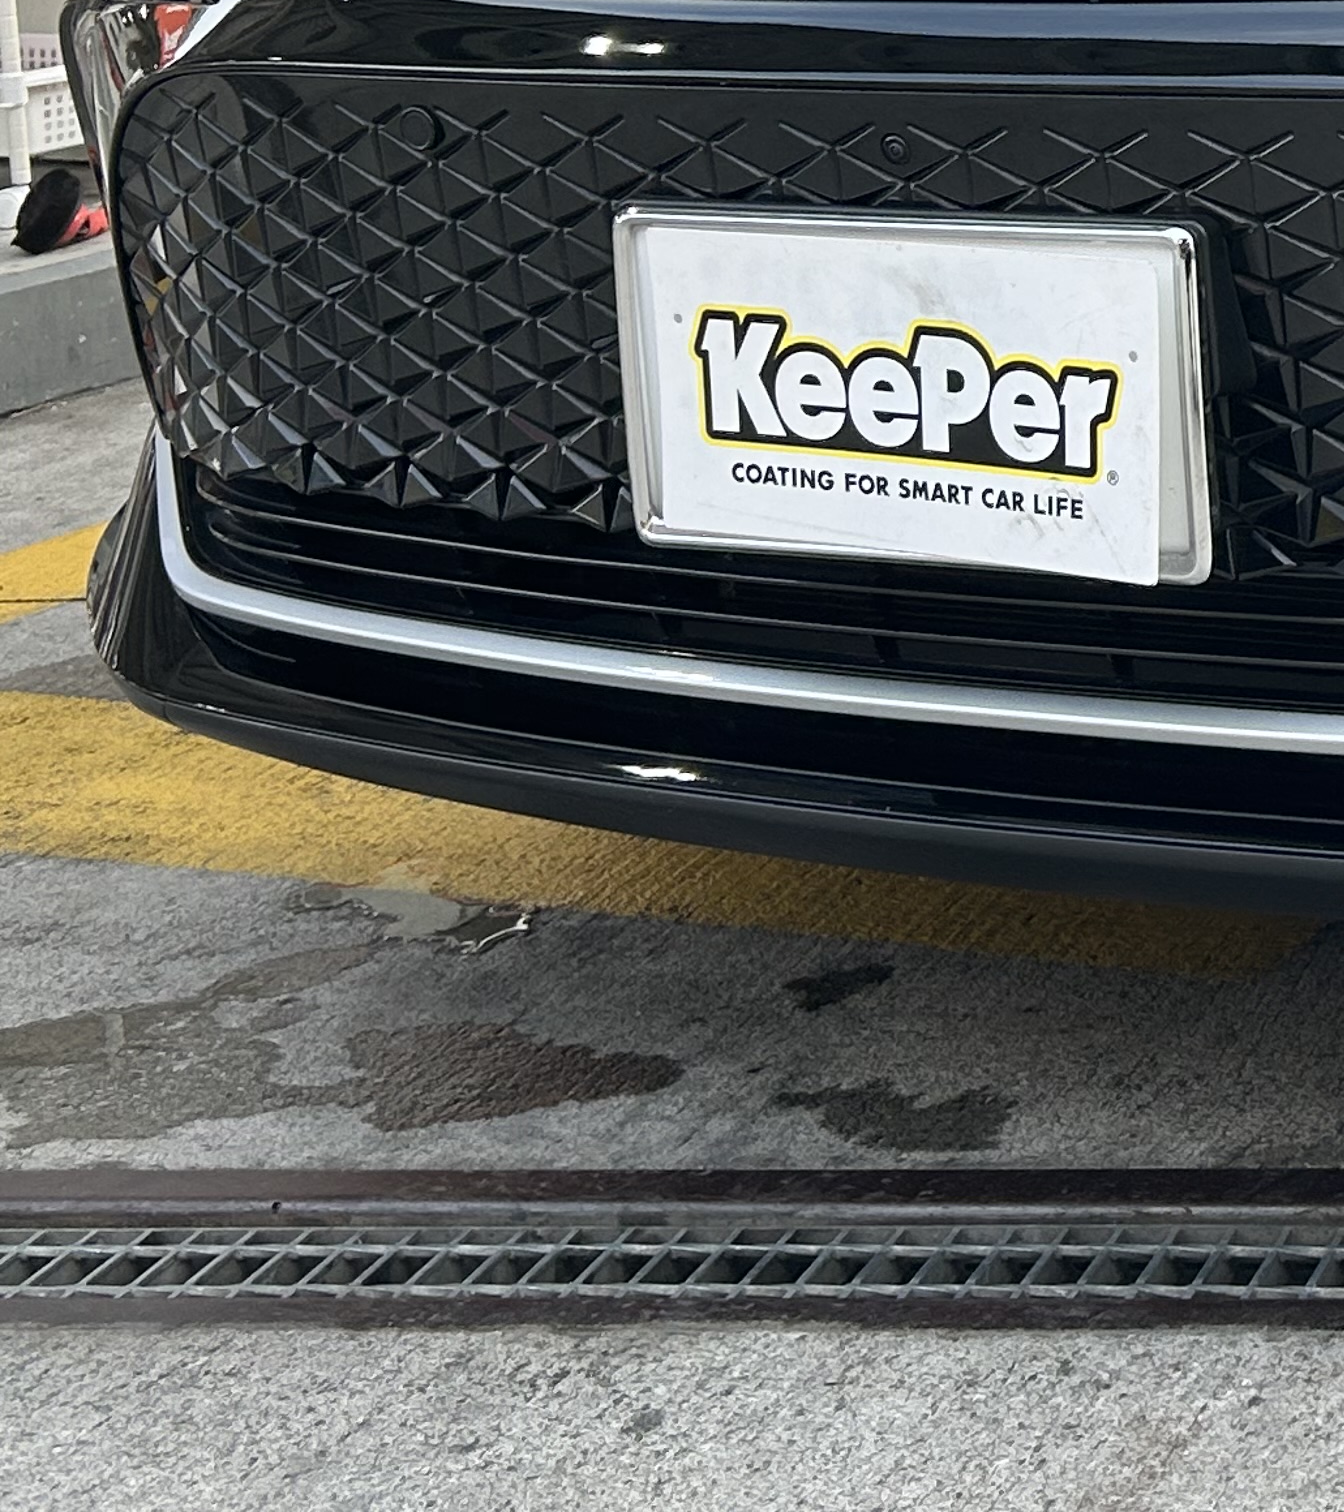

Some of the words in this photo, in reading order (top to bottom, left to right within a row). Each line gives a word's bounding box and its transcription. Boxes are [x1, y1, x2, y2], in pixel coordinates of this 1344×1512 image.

[700, 312, 1114, 476] KeePer
[731, 461, 835, 492] COATING
[844, 472, 891, 497] FOR
[897, 481, 974, 506] SMART
[980, 489, 1025, 513] CAR
[1033, 494, 1084, 520] LIFE
